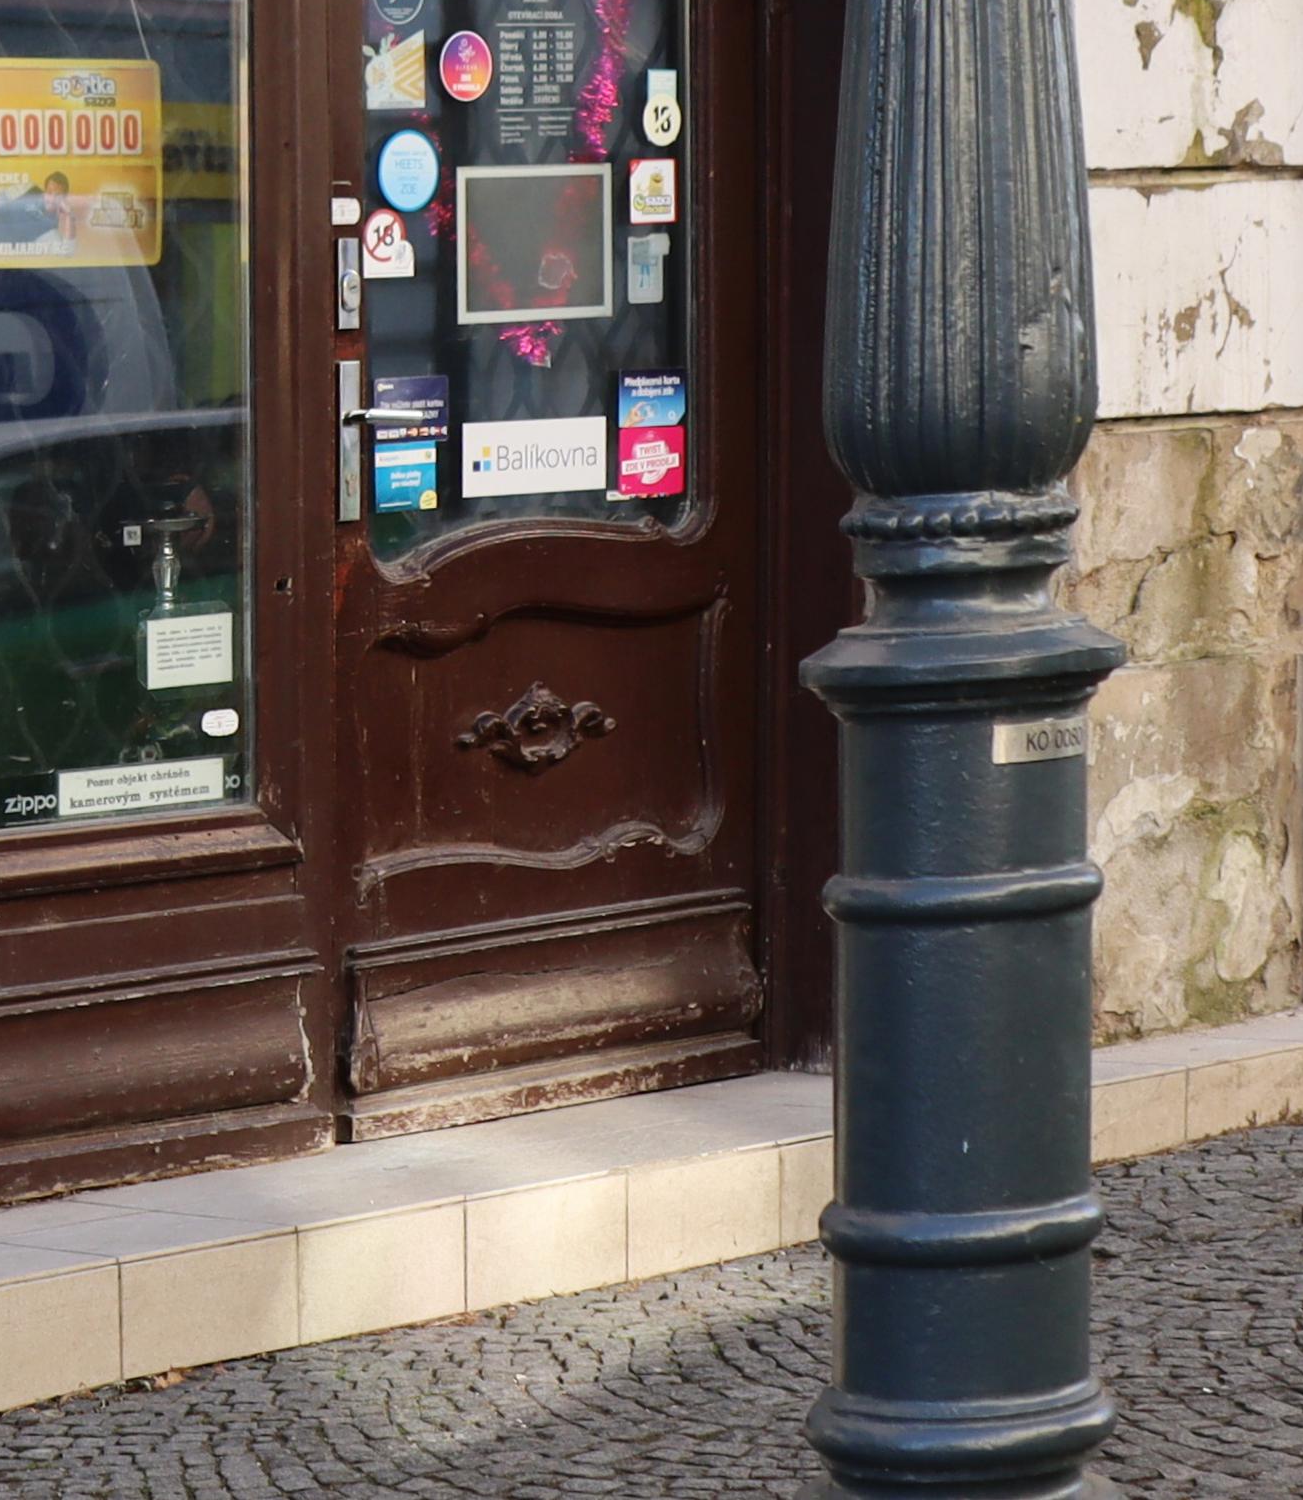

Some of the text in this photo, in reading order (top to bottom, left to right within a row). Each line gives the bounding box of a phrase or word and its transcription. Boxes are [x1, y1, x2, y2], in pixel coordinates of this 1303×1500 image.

[52, 73, 117, 97] sportka
[1, 114, 65, 150] 000
[76, 114, 138, 150] 000
[373, 225, 395, 247] 18
[497, 444, 598, 473] Balíkovna
[639, 444, 662, 457] TWIST
[1026, 730, 1049, 752] KO
[117, 773, 149, 787] objekt
[150, 768, 191, 781] chráněn
[4, 793, 57, 816] zippo
[69, 783, 211, 810] kamerovým systémem
